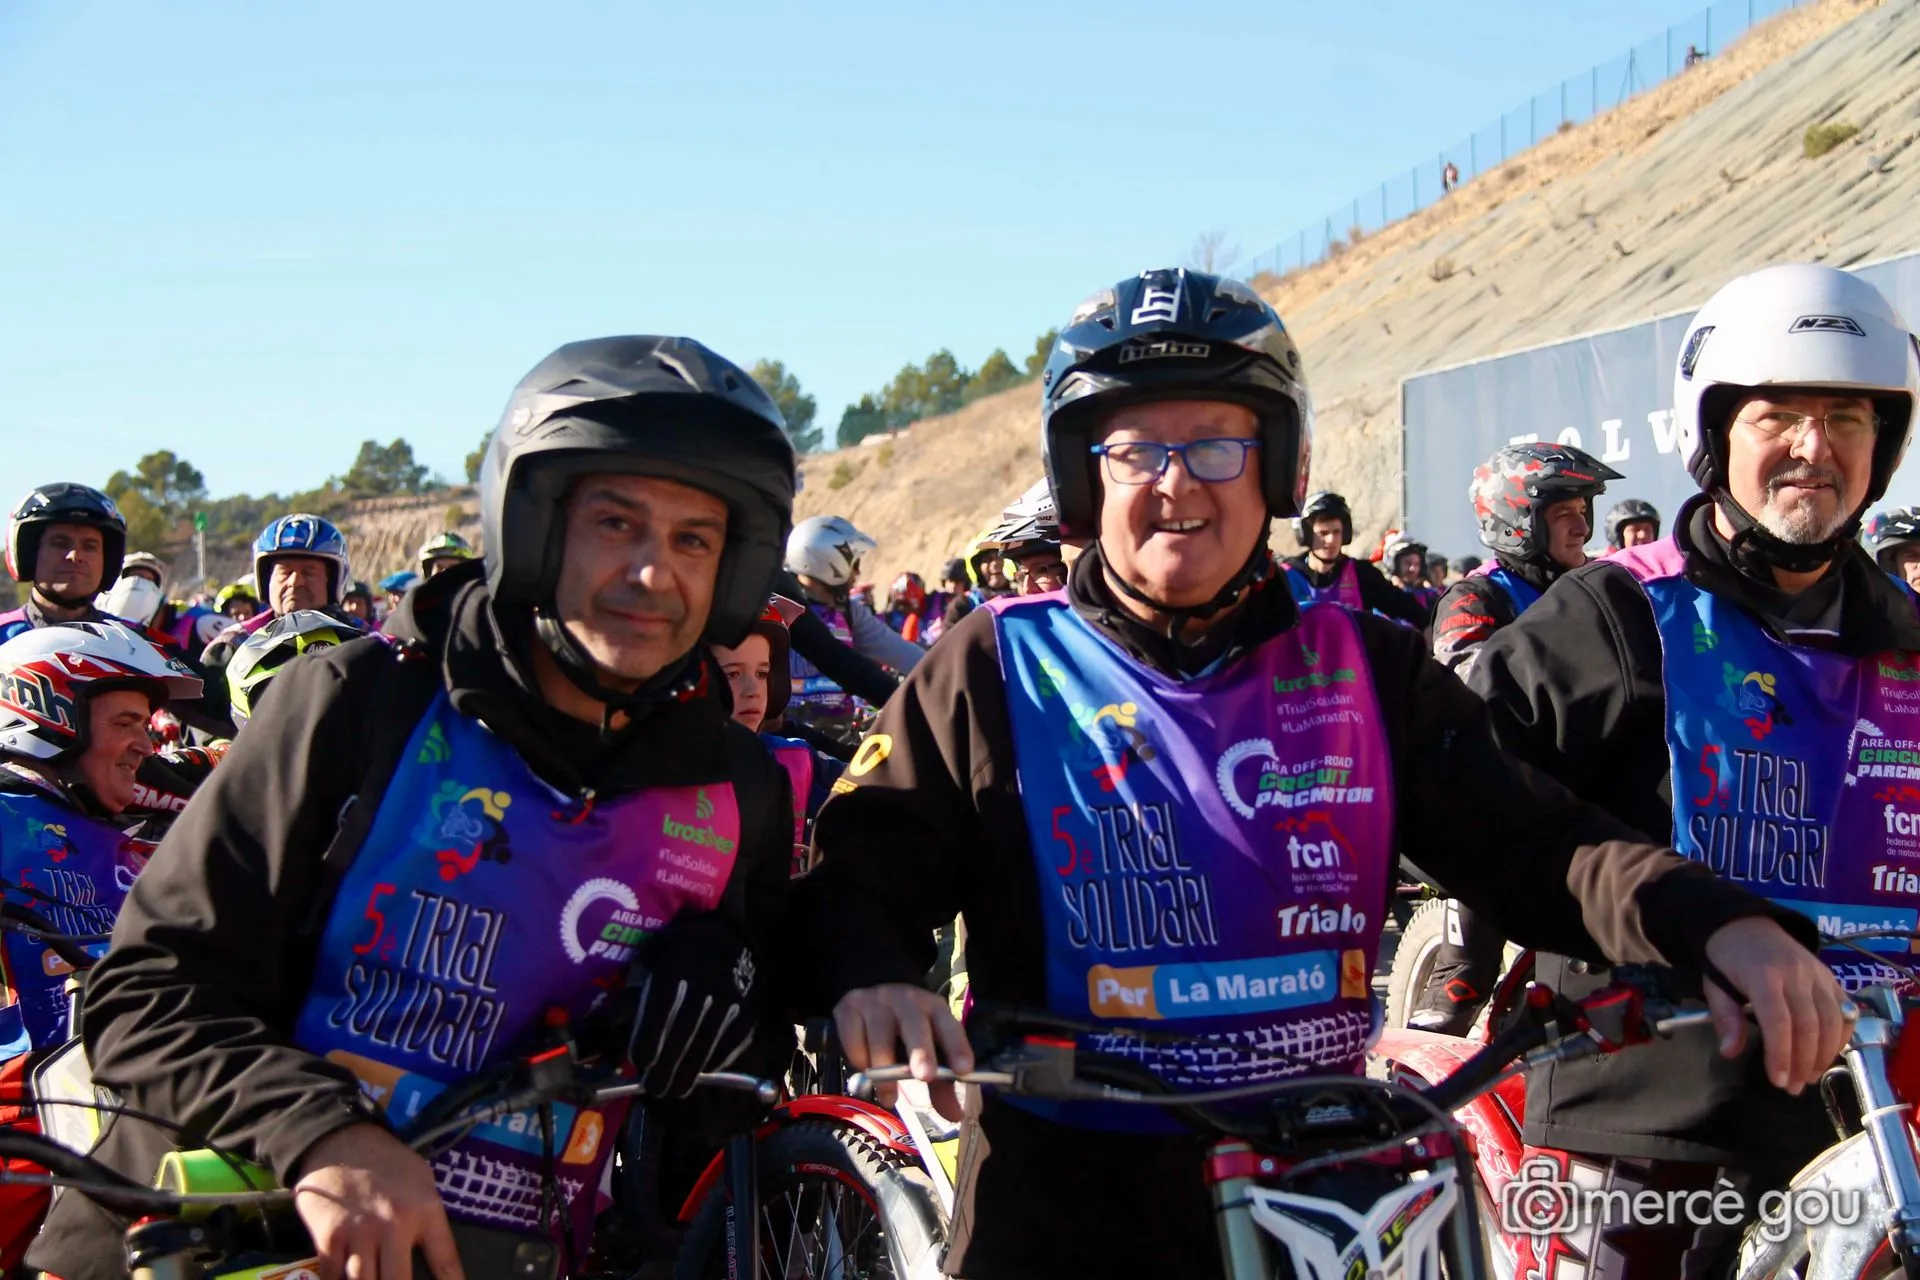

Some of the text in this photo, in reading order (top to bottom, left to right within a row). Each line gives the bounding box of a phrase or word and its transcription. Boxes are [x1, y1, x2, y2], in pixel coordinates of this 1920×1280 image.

[1861, 739, 1891, 748] AREA
[610, 909, 642, 925] AREA
[1097, 964, 1325, 1006] Per La Marató
